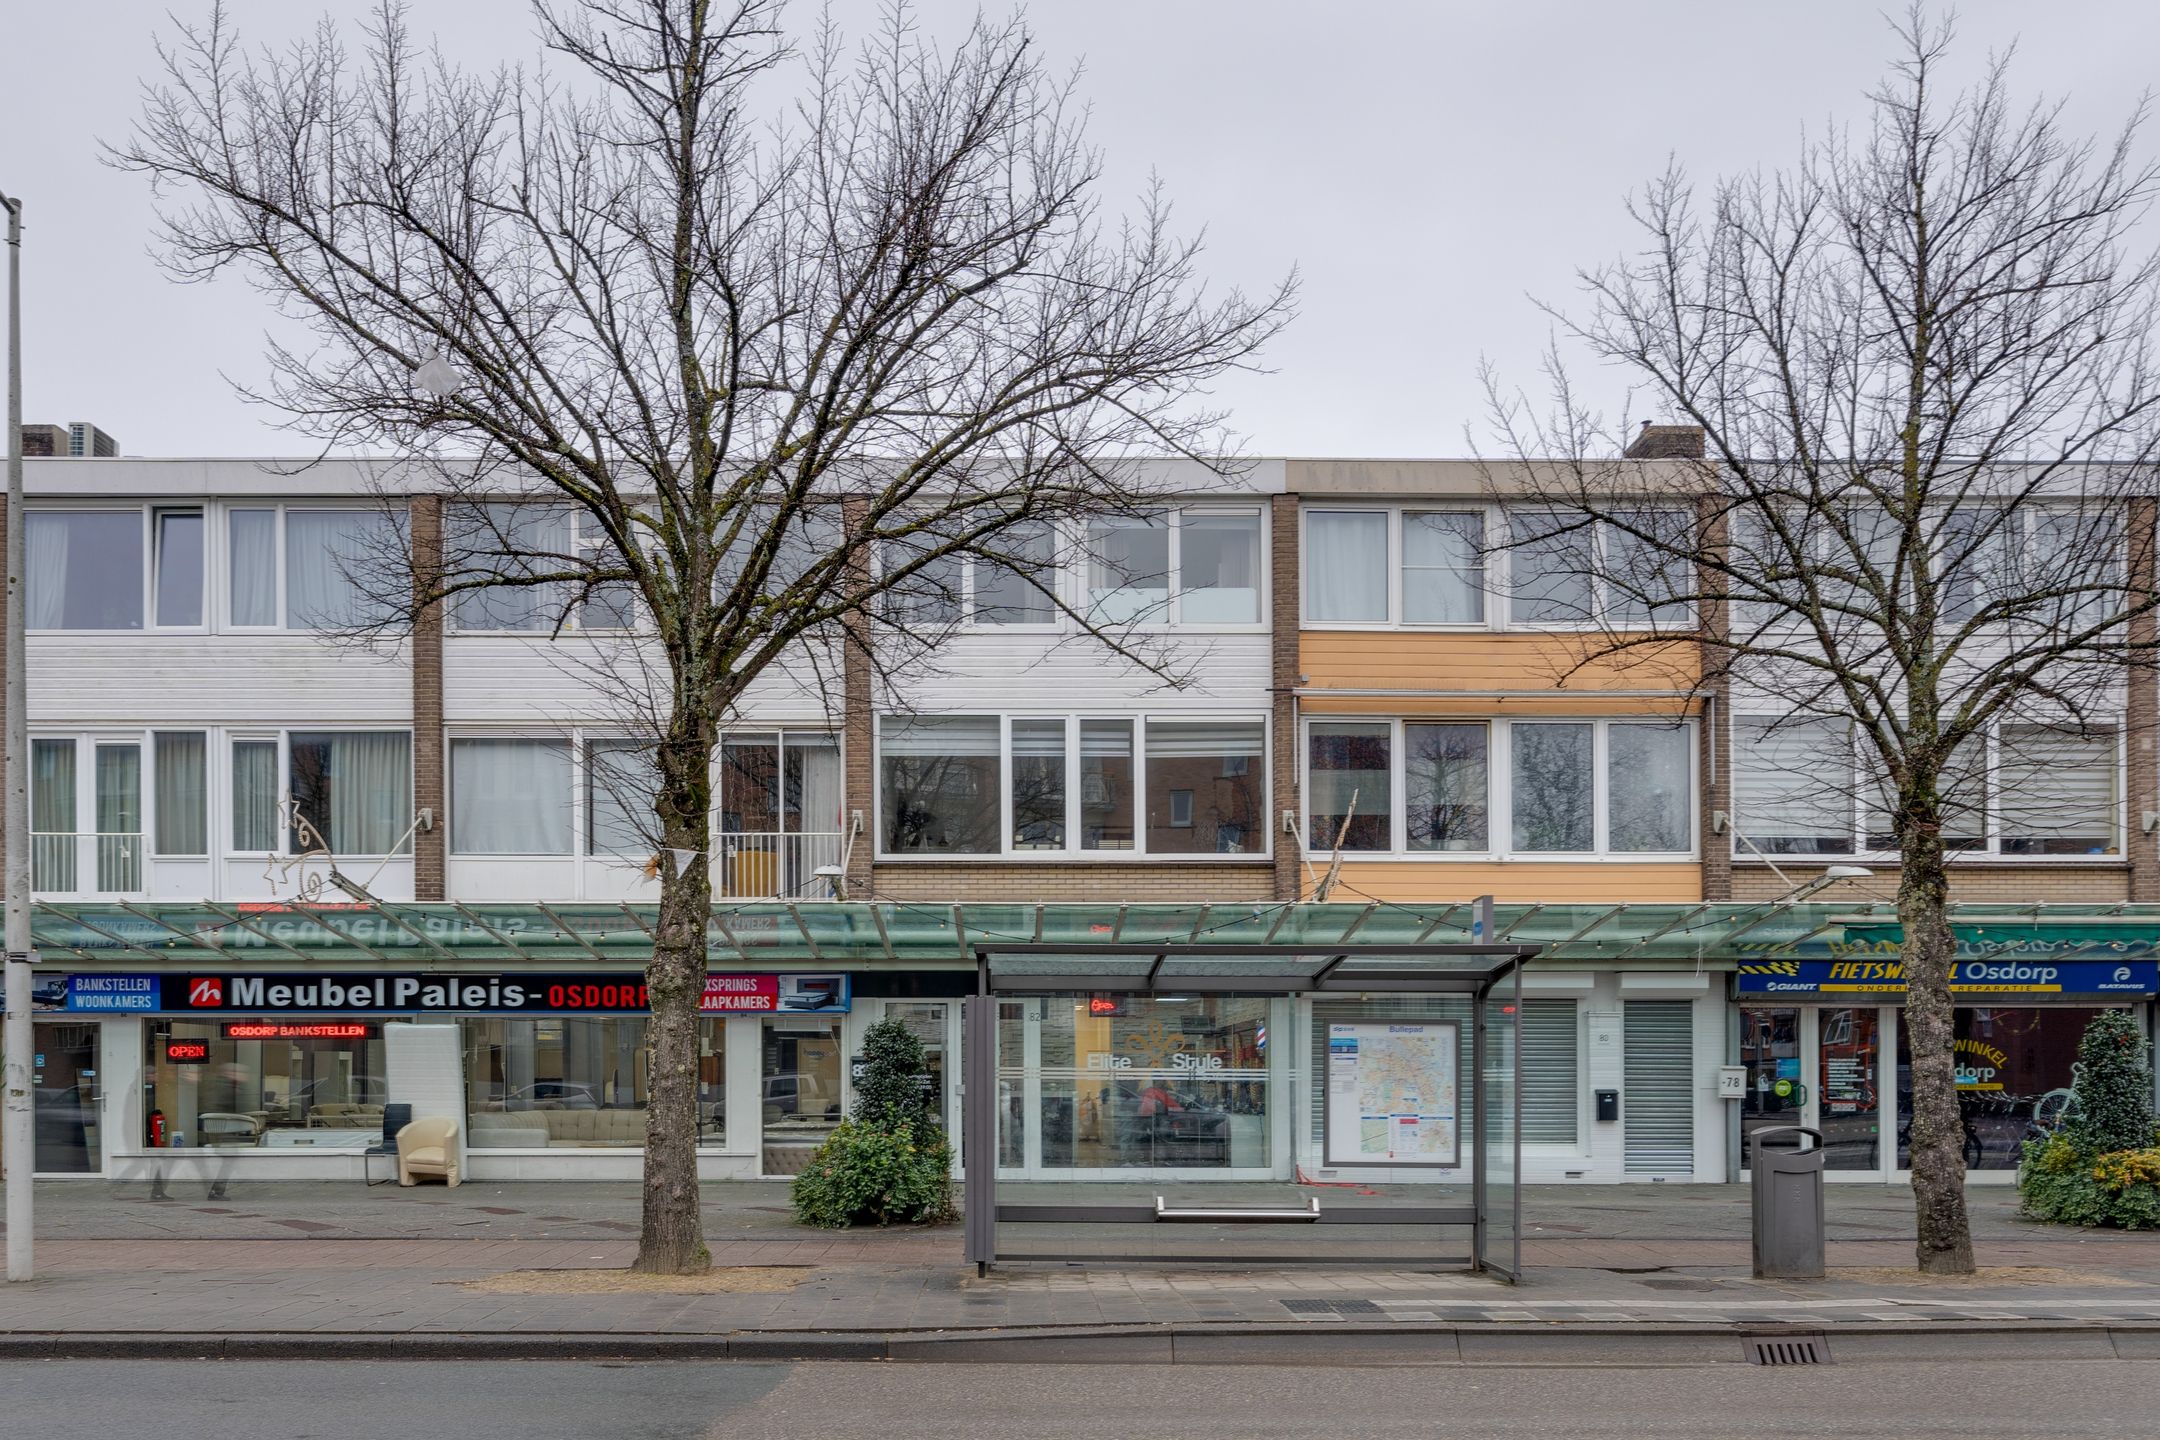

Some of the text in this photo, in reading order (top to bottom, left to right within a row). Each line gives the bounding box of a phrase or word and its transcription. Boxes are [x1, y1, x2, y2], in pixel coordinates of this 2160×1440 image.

[1966, 961, 2058, 984] Osdorp
[76, 978, 151, 991] BANKSTELLEN
[705, 978, 757, 991] XSPRINGS
[1776, 983, 1817, 991] GIANT
[231, 978, 385, 1006] Meubel
[75, 995, 152, 1008] WOONKAMERS
[700, 996, 770, 1008] AAPKAMERS
[1029, 1012, 1041, 1022] 82
[230, 1025, 365, 1035] OSDORP BANKSTELLEN
[168, 1046, 205, 1057] OPEN
[1087, 1053, 1223, 1075] Elite Style
[1954, 1062, 1996, 1082] dorp
